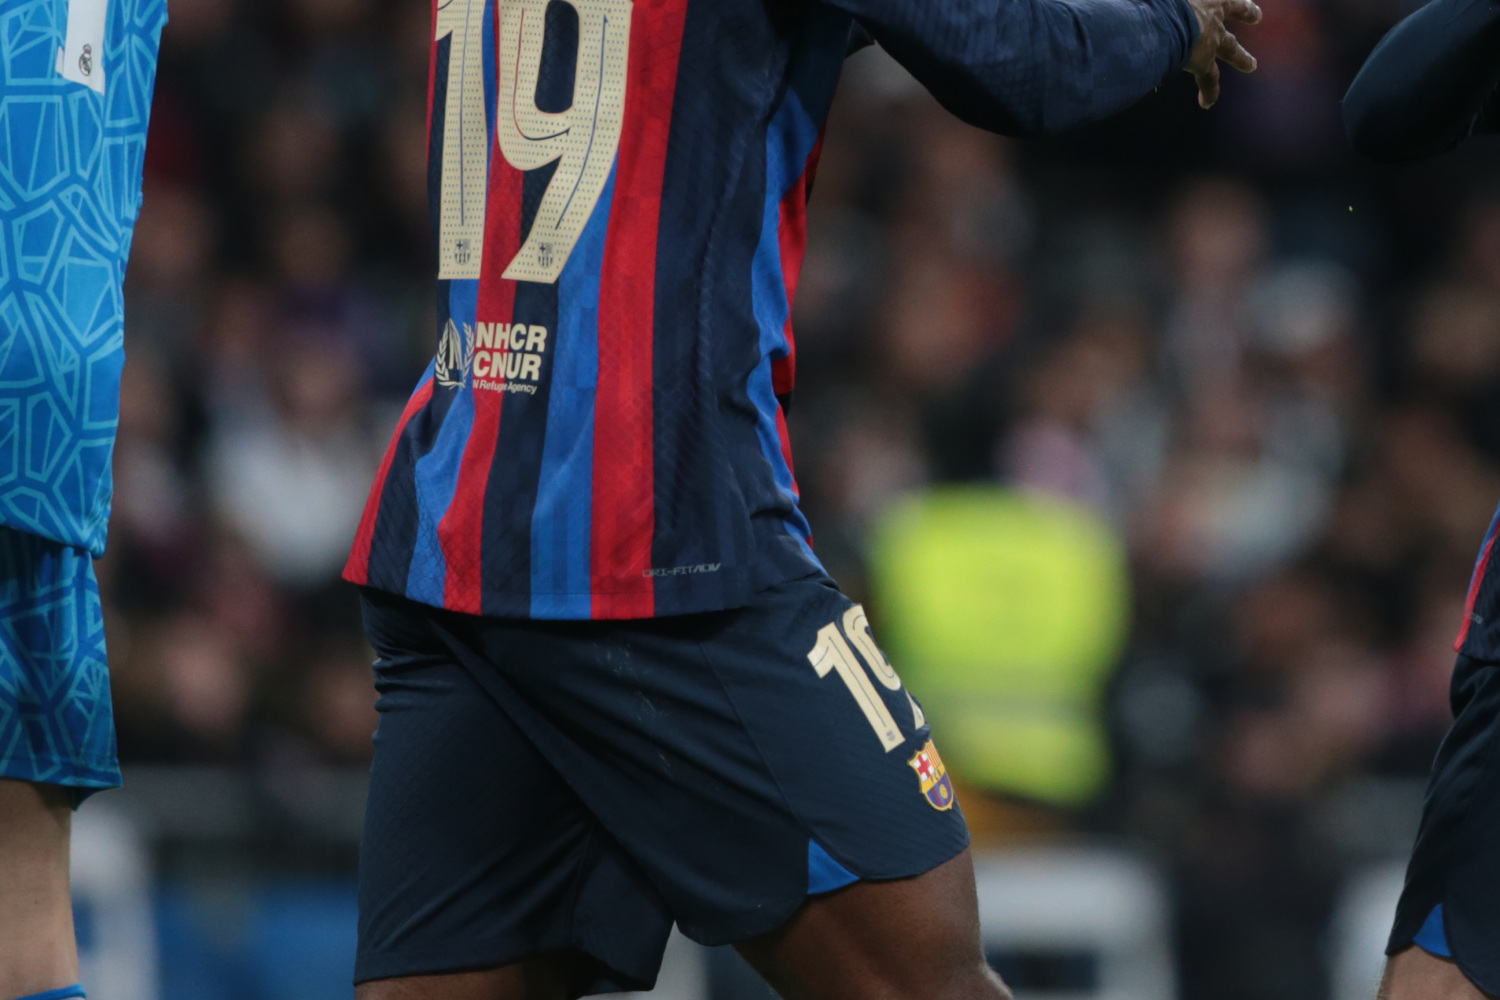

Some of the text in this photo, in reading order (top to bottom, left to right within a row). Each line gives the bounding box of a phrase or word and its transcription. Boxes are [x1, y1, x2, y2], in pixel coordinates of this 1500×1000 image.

[475, 321, 547, 352] NHCR
[473, 350, 542, 380] CNUR
[508, 381, 537, 395] Agency
